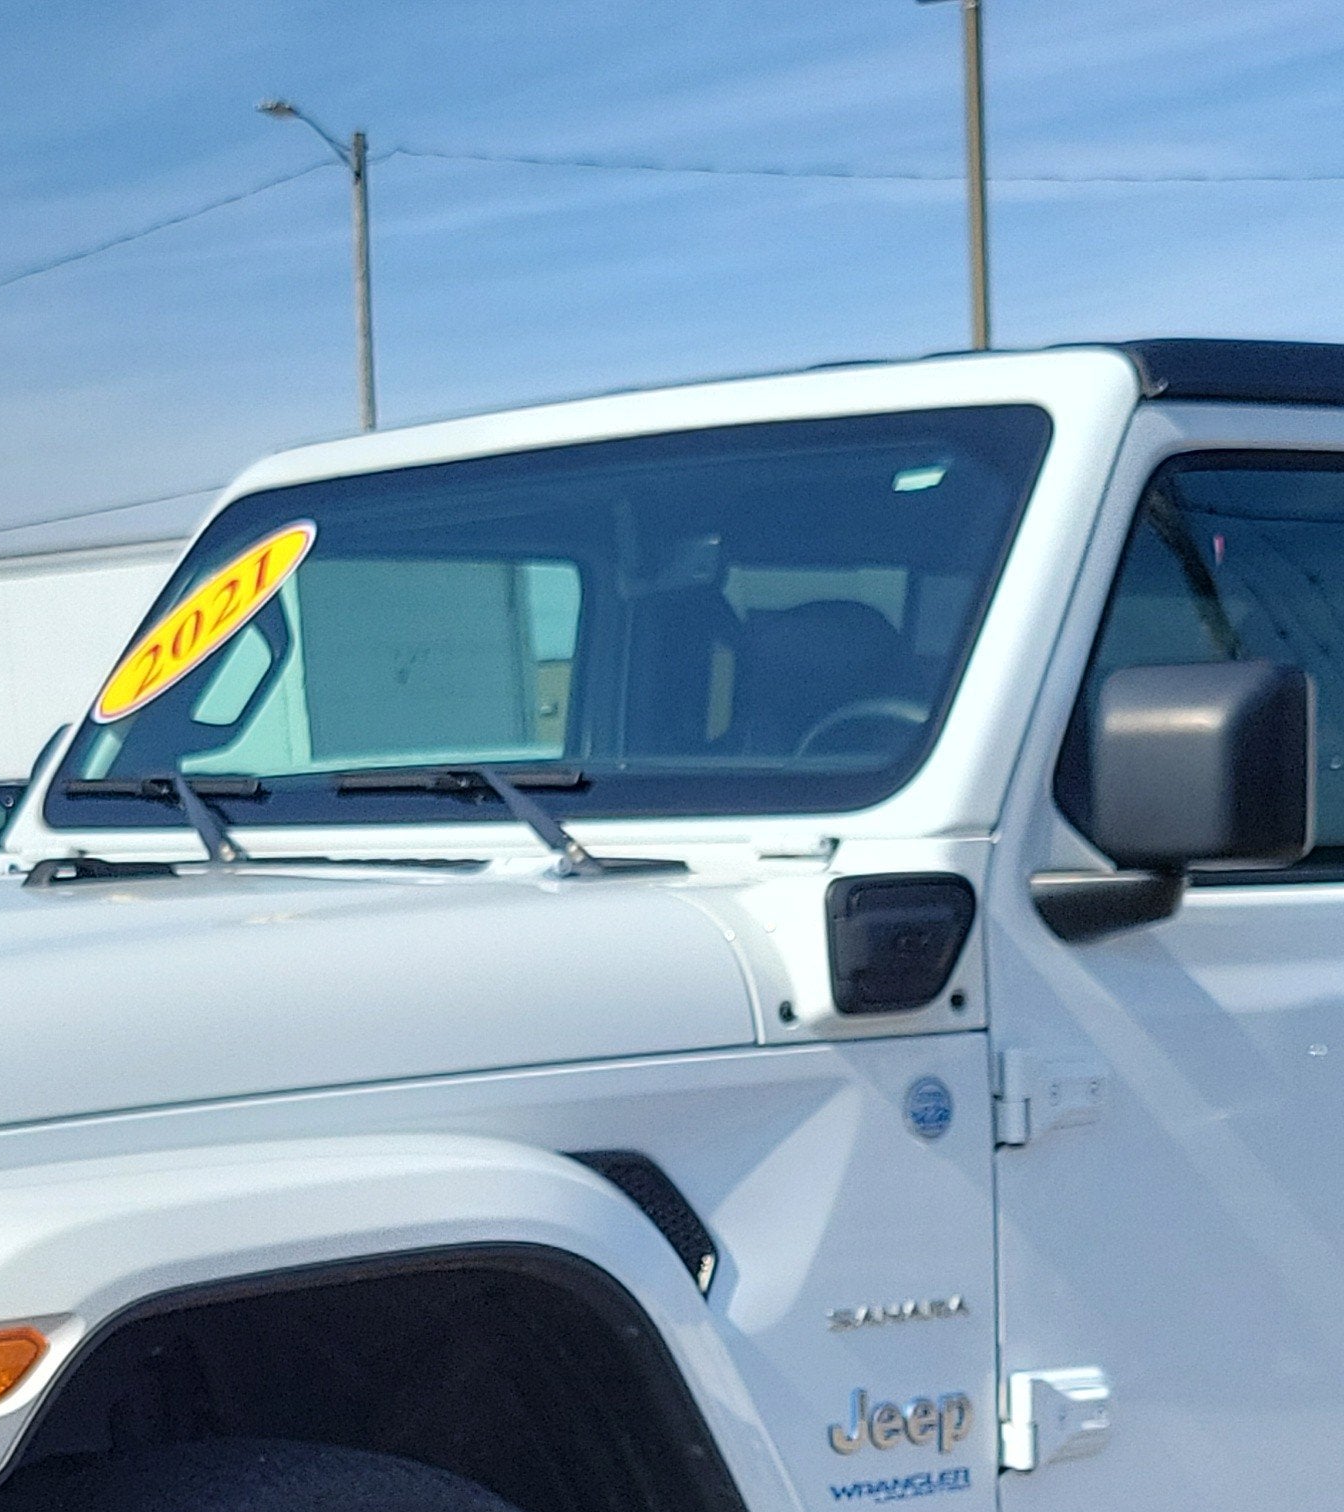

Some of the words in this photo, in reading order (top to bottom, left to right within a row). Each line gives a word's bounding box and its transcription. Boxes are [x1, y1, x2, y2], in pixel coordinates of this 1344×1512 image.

[131, 548, 273, 702] 2021
[827, 1387, 973, 1456] Jeep
[829, 1466, 970, 1500] WRANGLER
